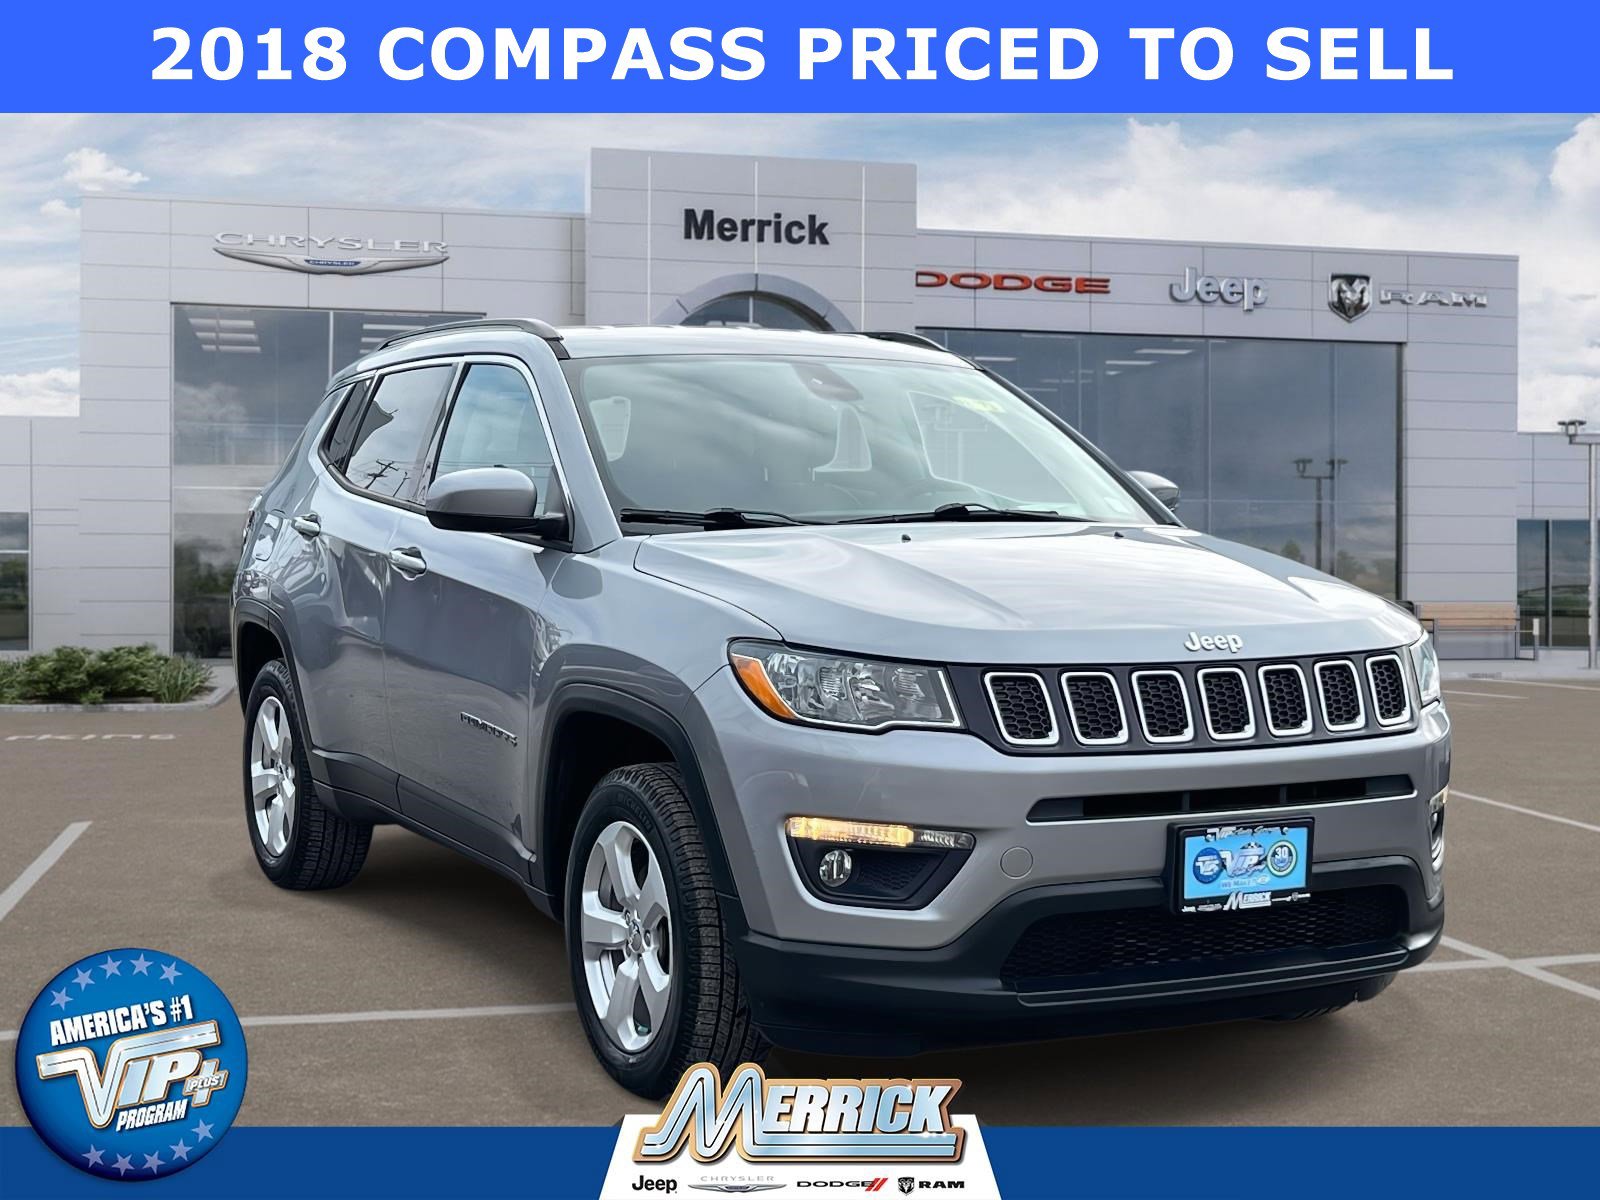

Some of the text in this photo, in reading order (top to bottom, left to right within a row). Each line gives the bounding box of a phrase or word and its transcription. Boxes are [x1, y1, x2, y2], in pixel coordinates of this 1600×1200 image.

[683, 207, 830, 246] Merrick
[214, 231, 450, 254] CHRYSLER
[915, 270, 1112, 295] DODGE
[1169, 266, 1269, 313] Jeep
[1380, 287, 1488, 308] RAM
[1184, 630, 1244, 654] Jeep
[1275, 846, 1288, 859] 30
